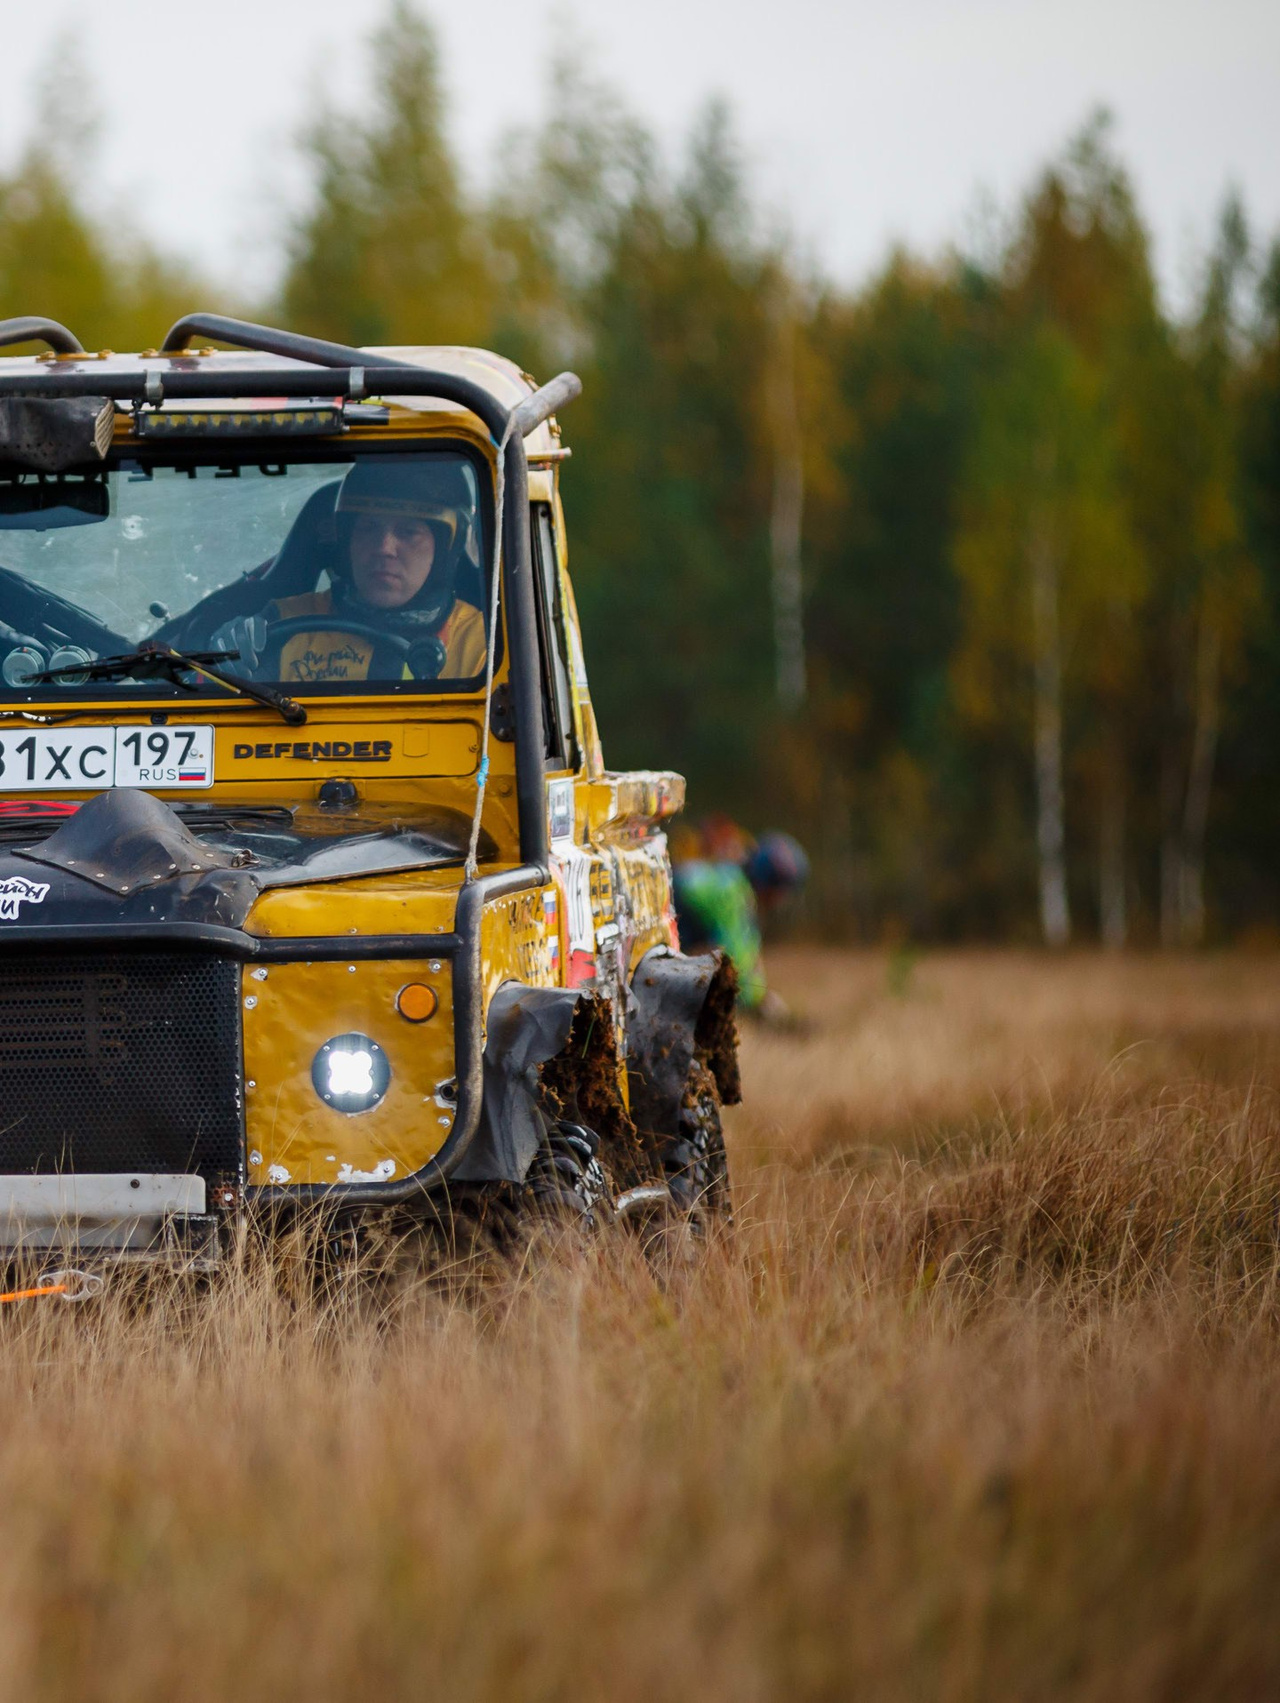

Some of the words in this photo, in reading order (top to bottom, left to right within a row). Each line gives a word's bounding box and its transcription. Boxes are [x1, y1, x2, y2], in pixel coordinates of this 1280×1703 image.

[122, 731, 196, 766] 197
[233, 740, 393, 759] DEFENDER
[139, 768, 177, 781] RUS
